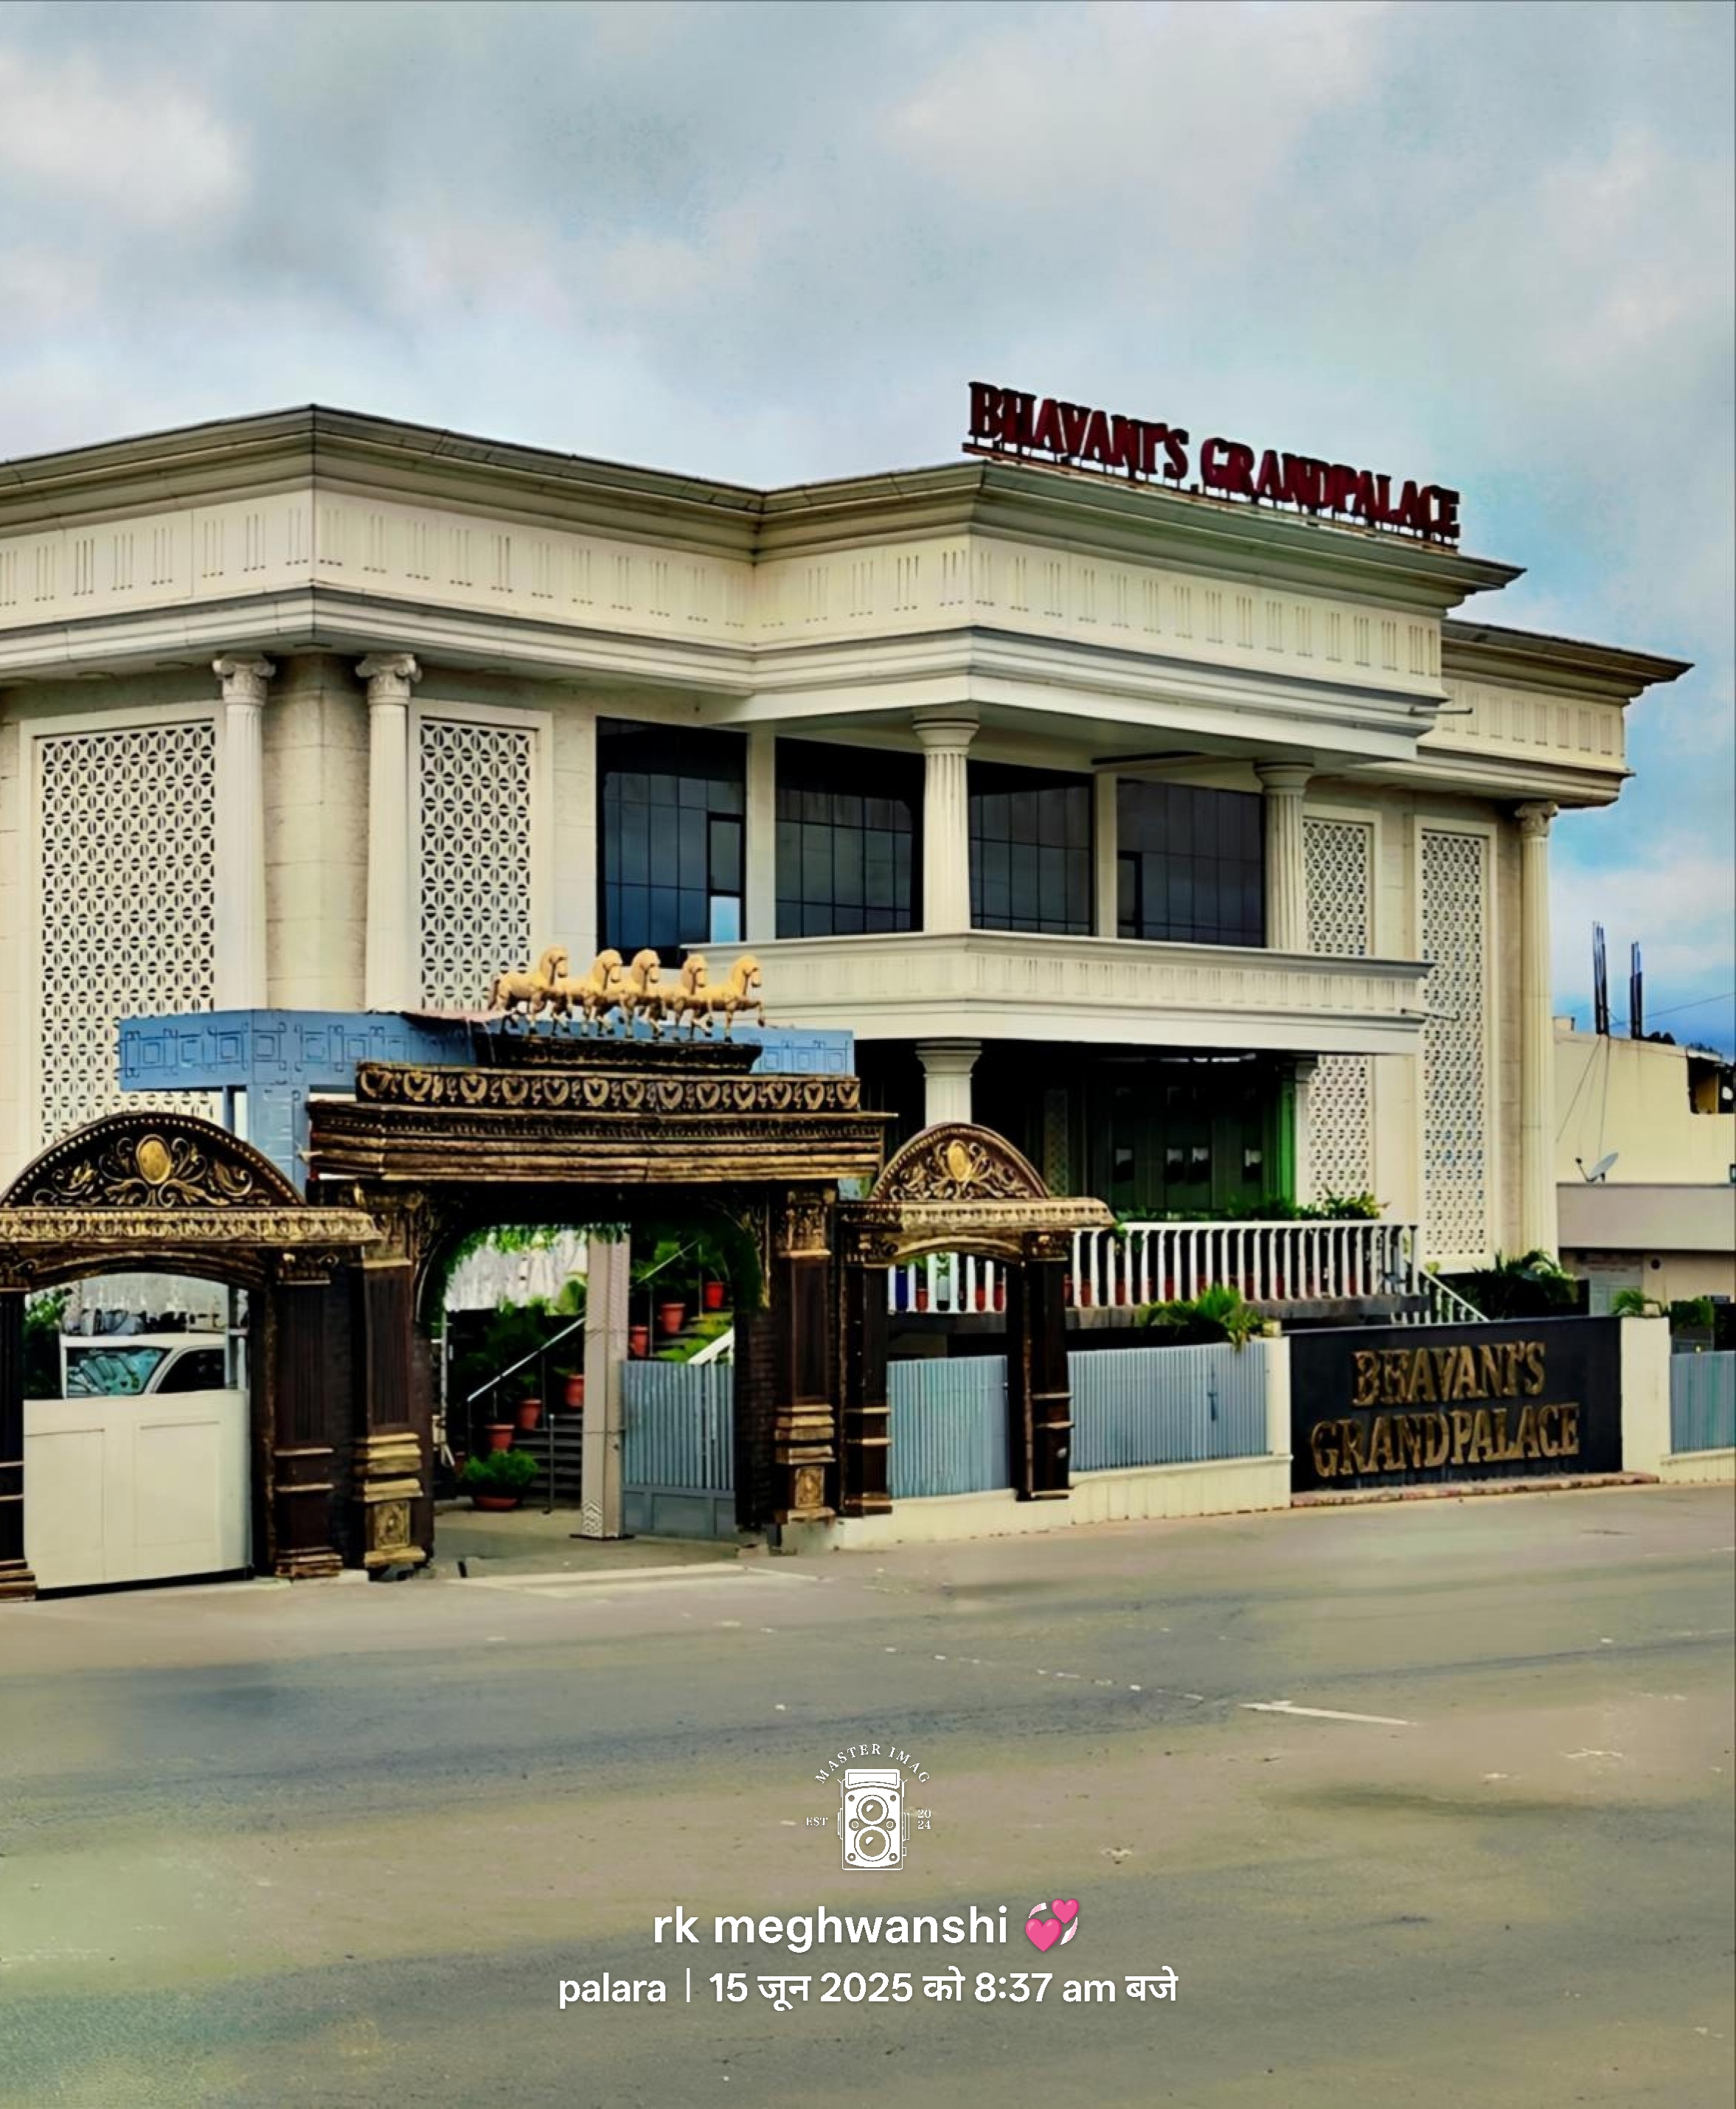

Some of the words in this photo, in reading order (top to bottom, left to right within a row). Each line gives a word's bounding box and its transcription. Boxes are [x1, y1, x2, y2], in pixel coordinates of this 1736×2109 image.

[968, 381, 1189, 480] BHAVANI'S
[1201, 437, 1460, 538] GRANDPALACE
[1352, 1340, 1546, 1408] BHAVANI'S
[1310, 1403, 1580, 1479] GRANDPALACE
